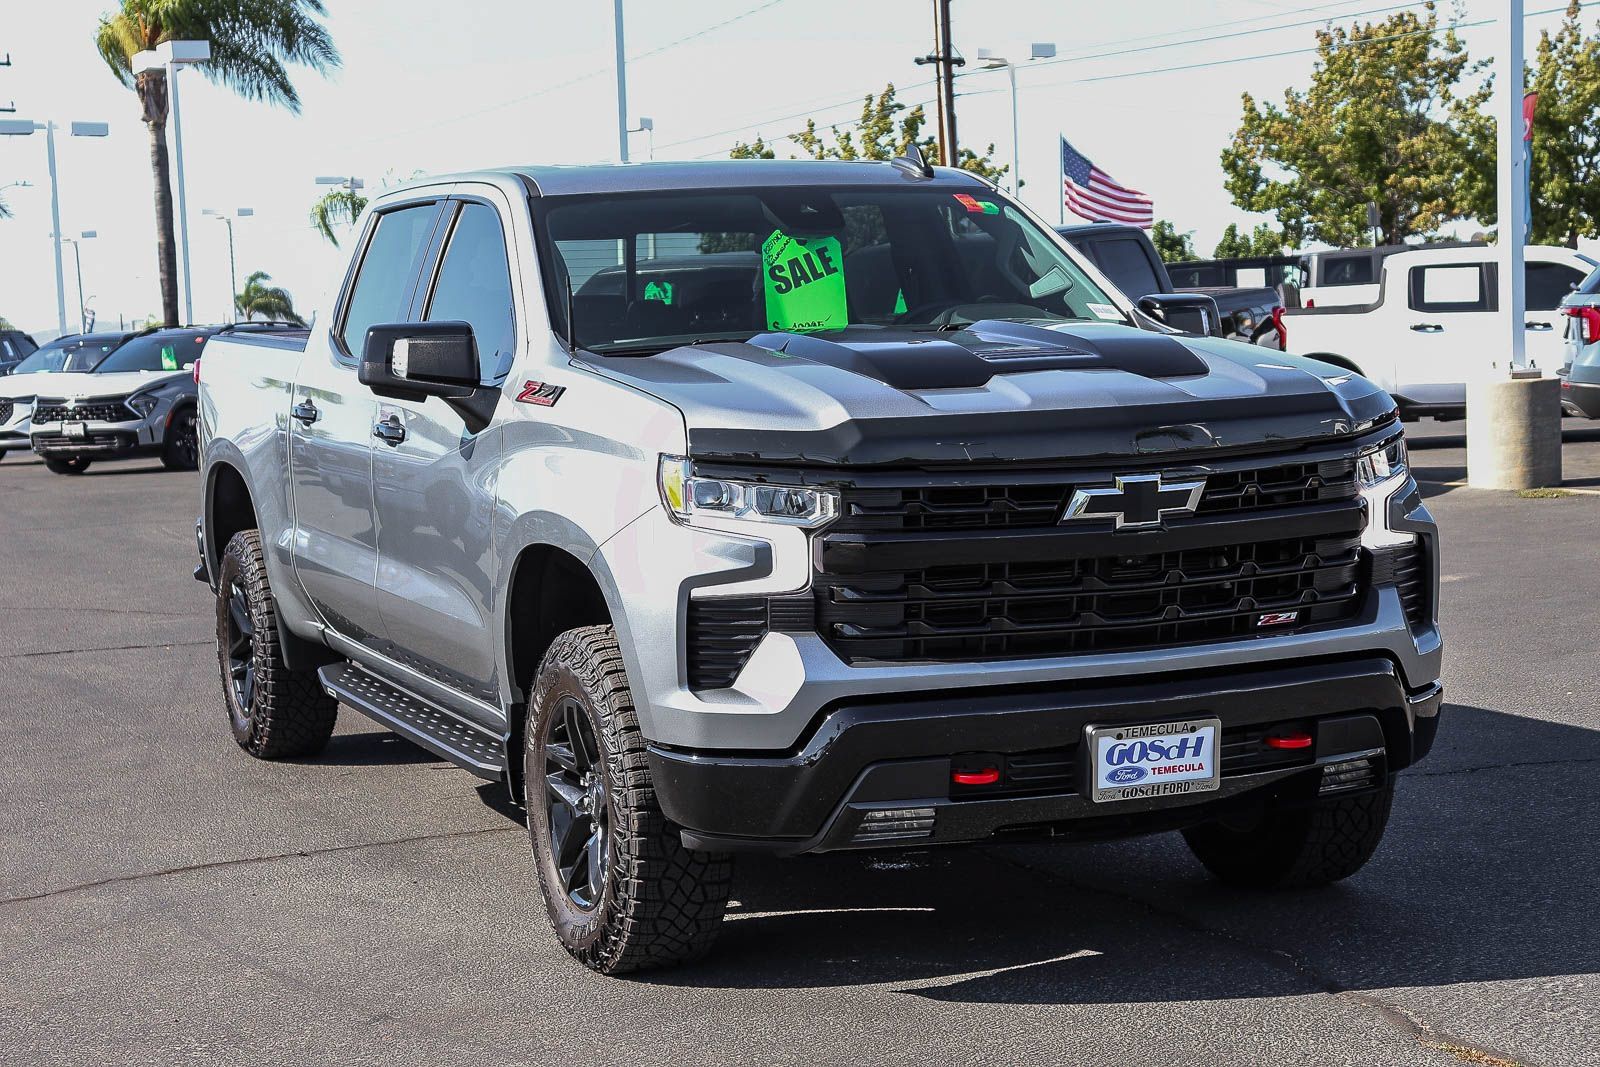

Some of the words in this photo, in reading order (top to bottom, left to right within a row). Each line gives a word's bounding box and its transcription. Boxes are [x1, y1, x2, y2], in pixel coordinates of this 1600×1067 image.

[768, 246, 839, 294] SALE
[515, 380, 567, 408] Z71
[1124, 722, 1189, 738] TEMECULA
[1114, 769, 1139, 781] Ford
[1151, 762, 1204, 775] TEMECULA
[1162, 781, 1190, 795] FORD
